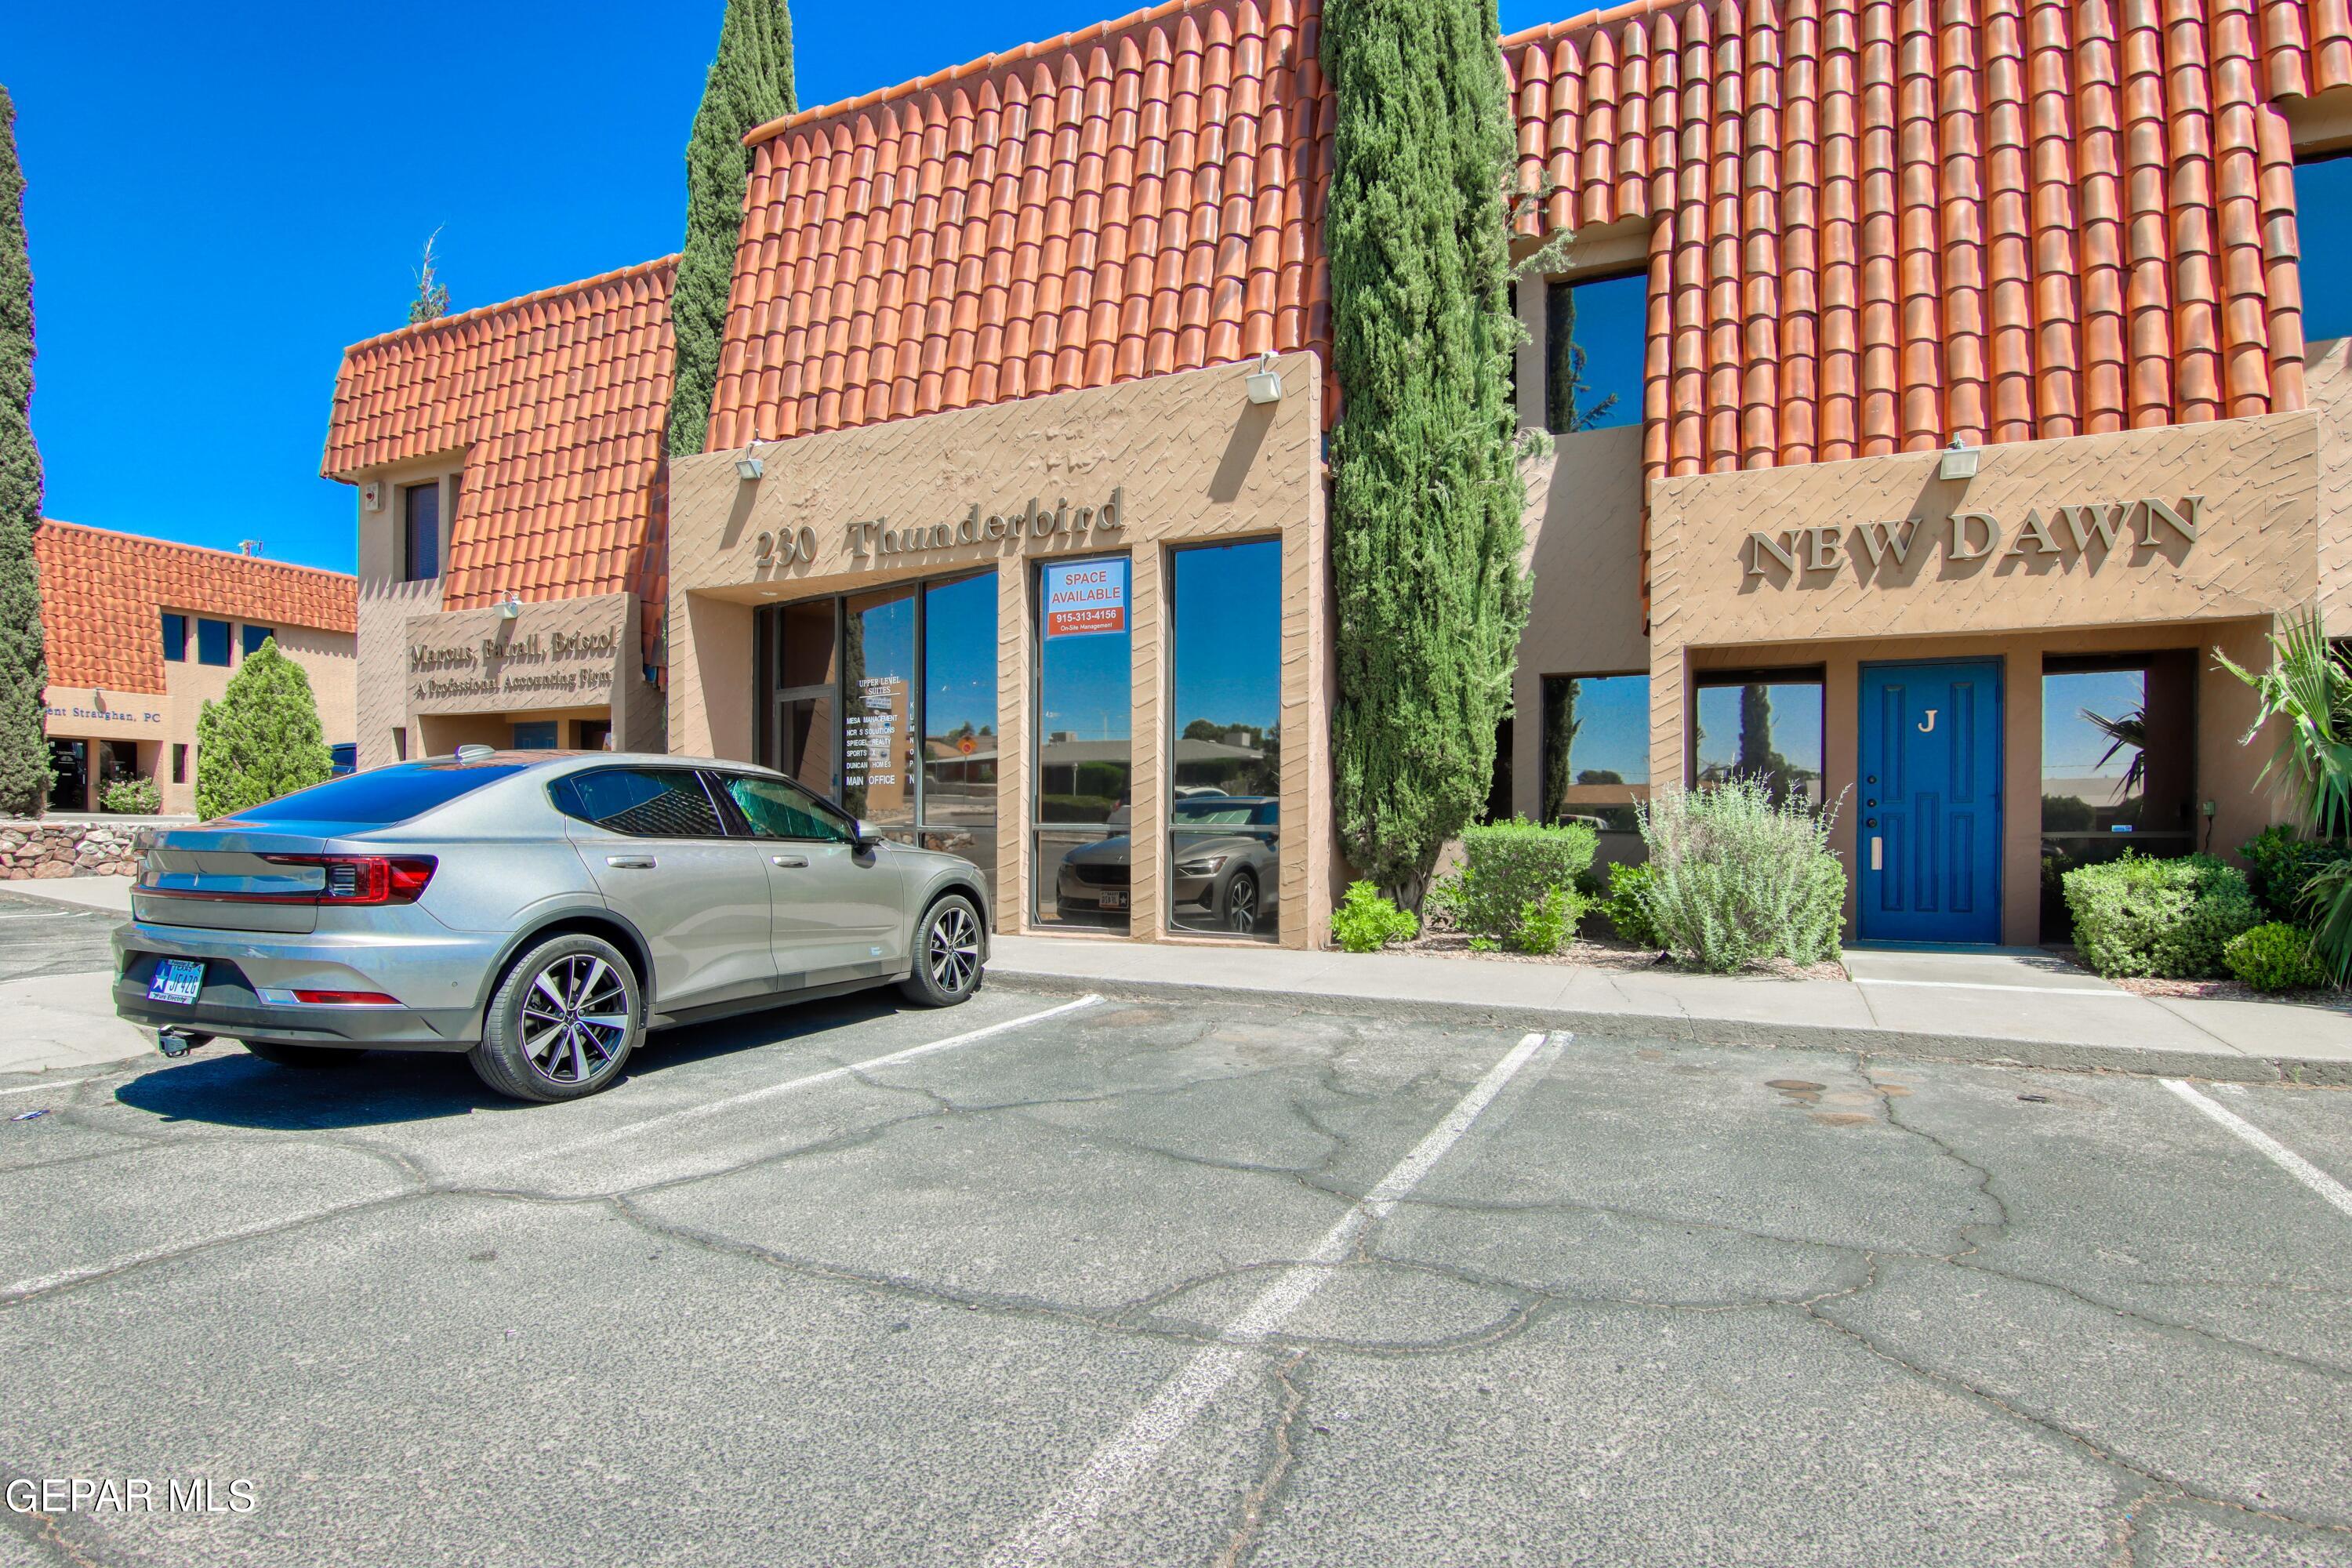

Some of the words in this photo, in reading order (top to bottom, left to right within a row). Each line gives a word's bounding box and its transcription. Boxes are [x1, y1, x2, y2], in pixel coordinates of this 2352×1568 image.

[757, 525, 817, 568] 230
[847, 485, 1127, 557] Thunderbird
[1748, 517, 1922, 575] NEW
[1947, 495, 2205, 561] DAWN
[1066, 571, 1106, 585] SPACE
[1052, 587, 1120, 604] AVAILABLE
[1057, 610, 1116, 622] 915-313-4156
[412, 644, 478, 666] Marcus,
[484, 633, 547, 659] Fairall,
[552, 625, 618, 653] Bristol
[416, 681, 426, 695] A
[430, 673, 501, 693] Professional
[506, 670, 576, 688] Accounting
[580, 668, 614, 684] Firm
[859, 679, 878, 688] UPPER
[881, 676, 901, 685] LEVEL
[869, 686, 891, 695] SUITES
[45, 707, 67, 716] ent
[73, 707, 136, 722] Straughan,
[144, 713, 161, 723] PC
[863, 714, 898, 724] MANAGEMENT
[1918, 710, 1938, 733] J
[864, 727, 895, 735] SOLUTIONS
[847, 776, 863, 786] MAIN
[869, 775, 895, 785] OFFICE
[909, 775, 915, 784] N
